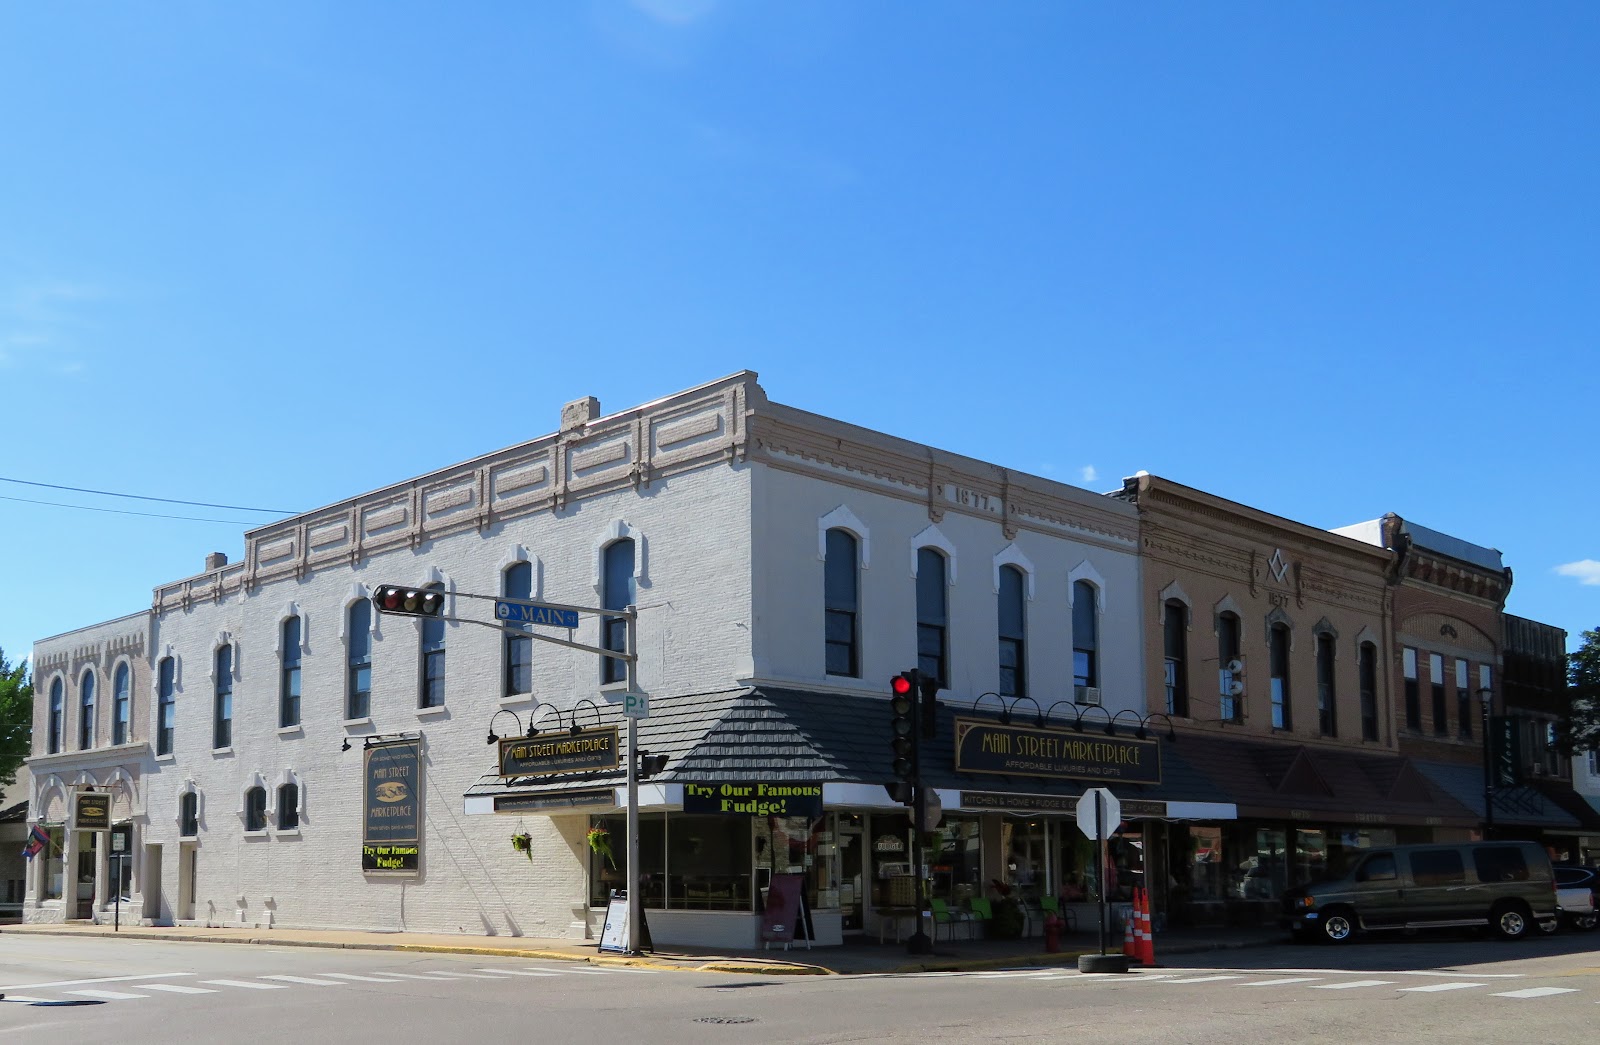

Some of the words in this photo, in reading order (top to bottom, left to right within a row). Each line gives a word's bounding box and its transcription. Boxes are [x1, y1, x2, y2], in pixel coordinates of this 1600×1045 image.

[520, 606, 564, 624] MAIN
[567, 615, 575, 623] ST
[511, 746, 527, 759] MAIN
[529, 743, 555, 758] STREET
[555, 738, 609, 755] MARKETPLACE
[982, 733, 1010, 754] MAIN
[1017, 735, 1058, 758] STREET
[1063, 741, 1140, 765] MARKETPLACE
[1499, 720, 1515, 784] Welcome
[389, 766, 409, 778] STREET
[1005, 761, 1052, 771] AFFORDABLE
[1054, 764, 1085, 773] LUXURIES
[1103, 767, 1120, 775] GIFTS
[685, 783, 716, 798] Try
[720, 783, 752, 796] Our
[757, 783, 821, 796] Famous
[720, 799, 786, 816] Fudge!
[964, 796, 997, 805] KITCHEN
[999, 797, 1005, 805] &
[1007, 798, 1029, 806] HOME
[1036, 800, 1059, 808] FUDGE
[370, 805, 411, 818] MARKETPLACE
[364, 846, 374, 857] Try
[377, 847, 390, 855] Our
[392, 846, 417, 855] Famous
[377, 857, 404, 869] Fudge!
